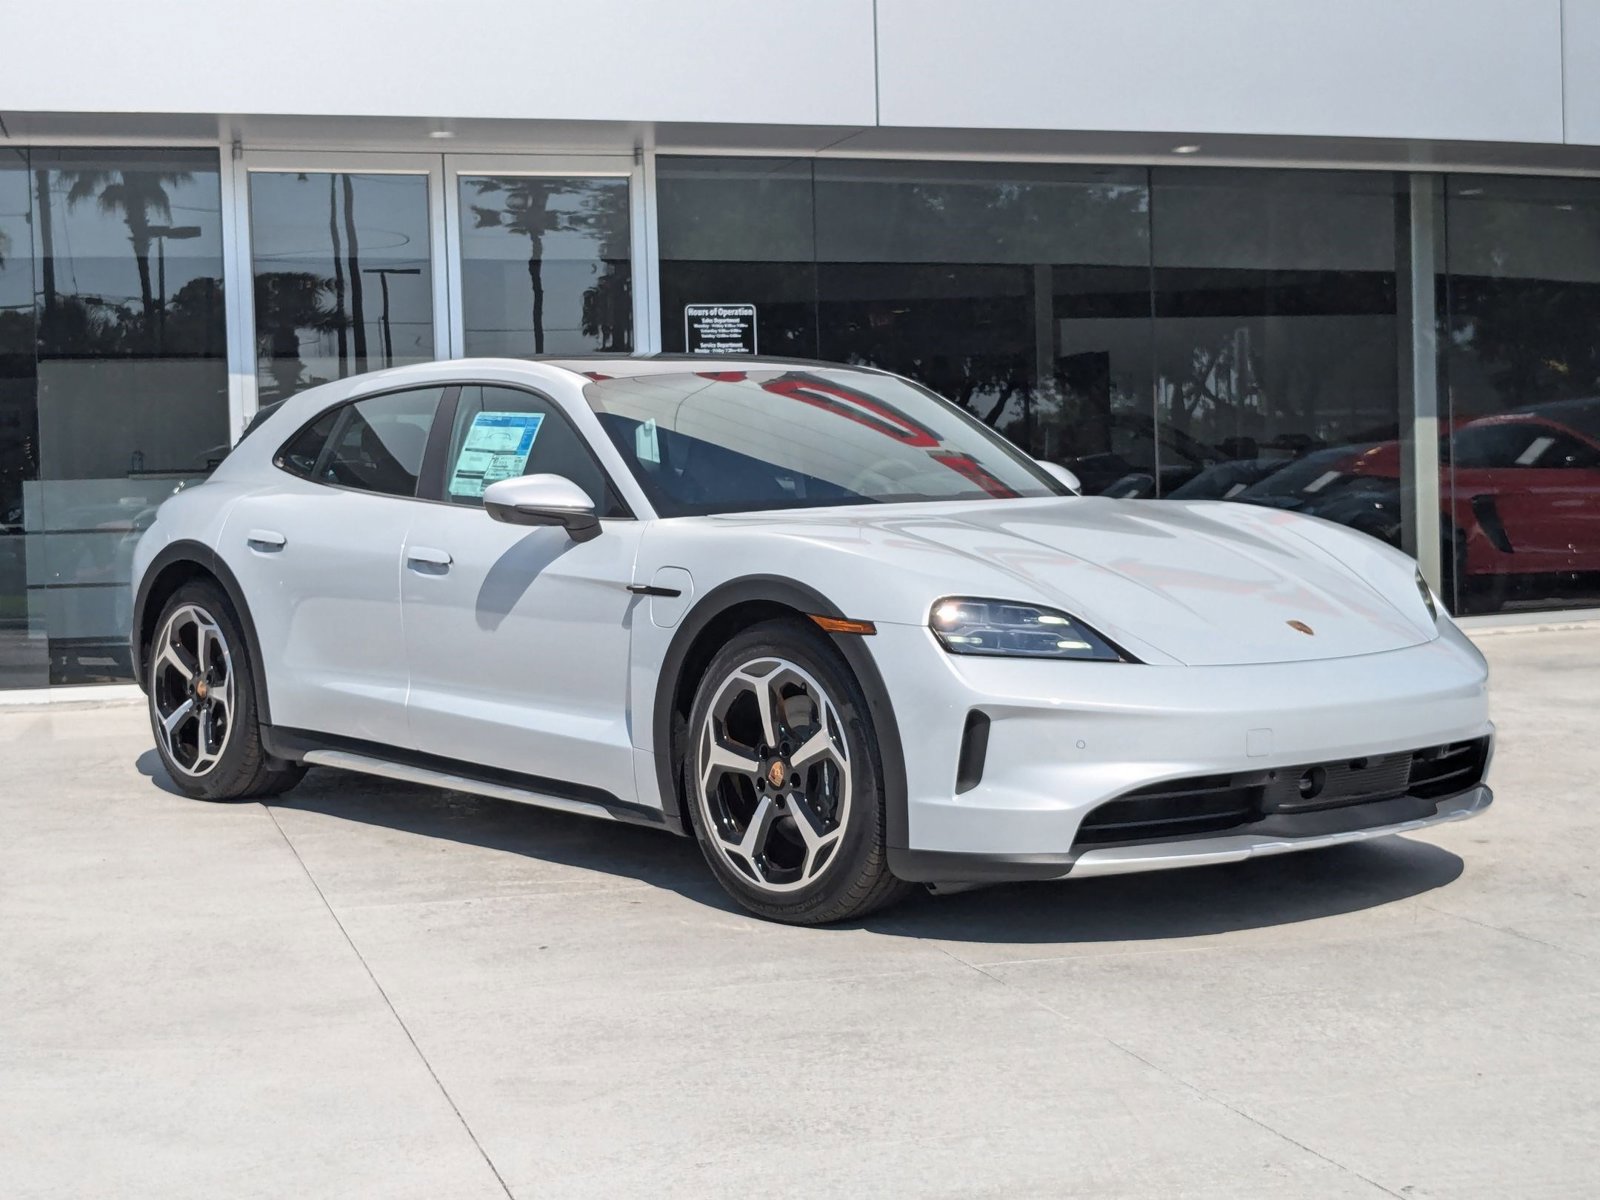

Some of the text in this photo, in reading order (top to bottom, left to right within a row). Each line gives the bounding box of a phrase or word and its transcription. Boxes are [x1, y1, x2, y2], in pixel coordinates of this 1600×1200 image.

[688, 307, 753, 317] Hours of Operation
